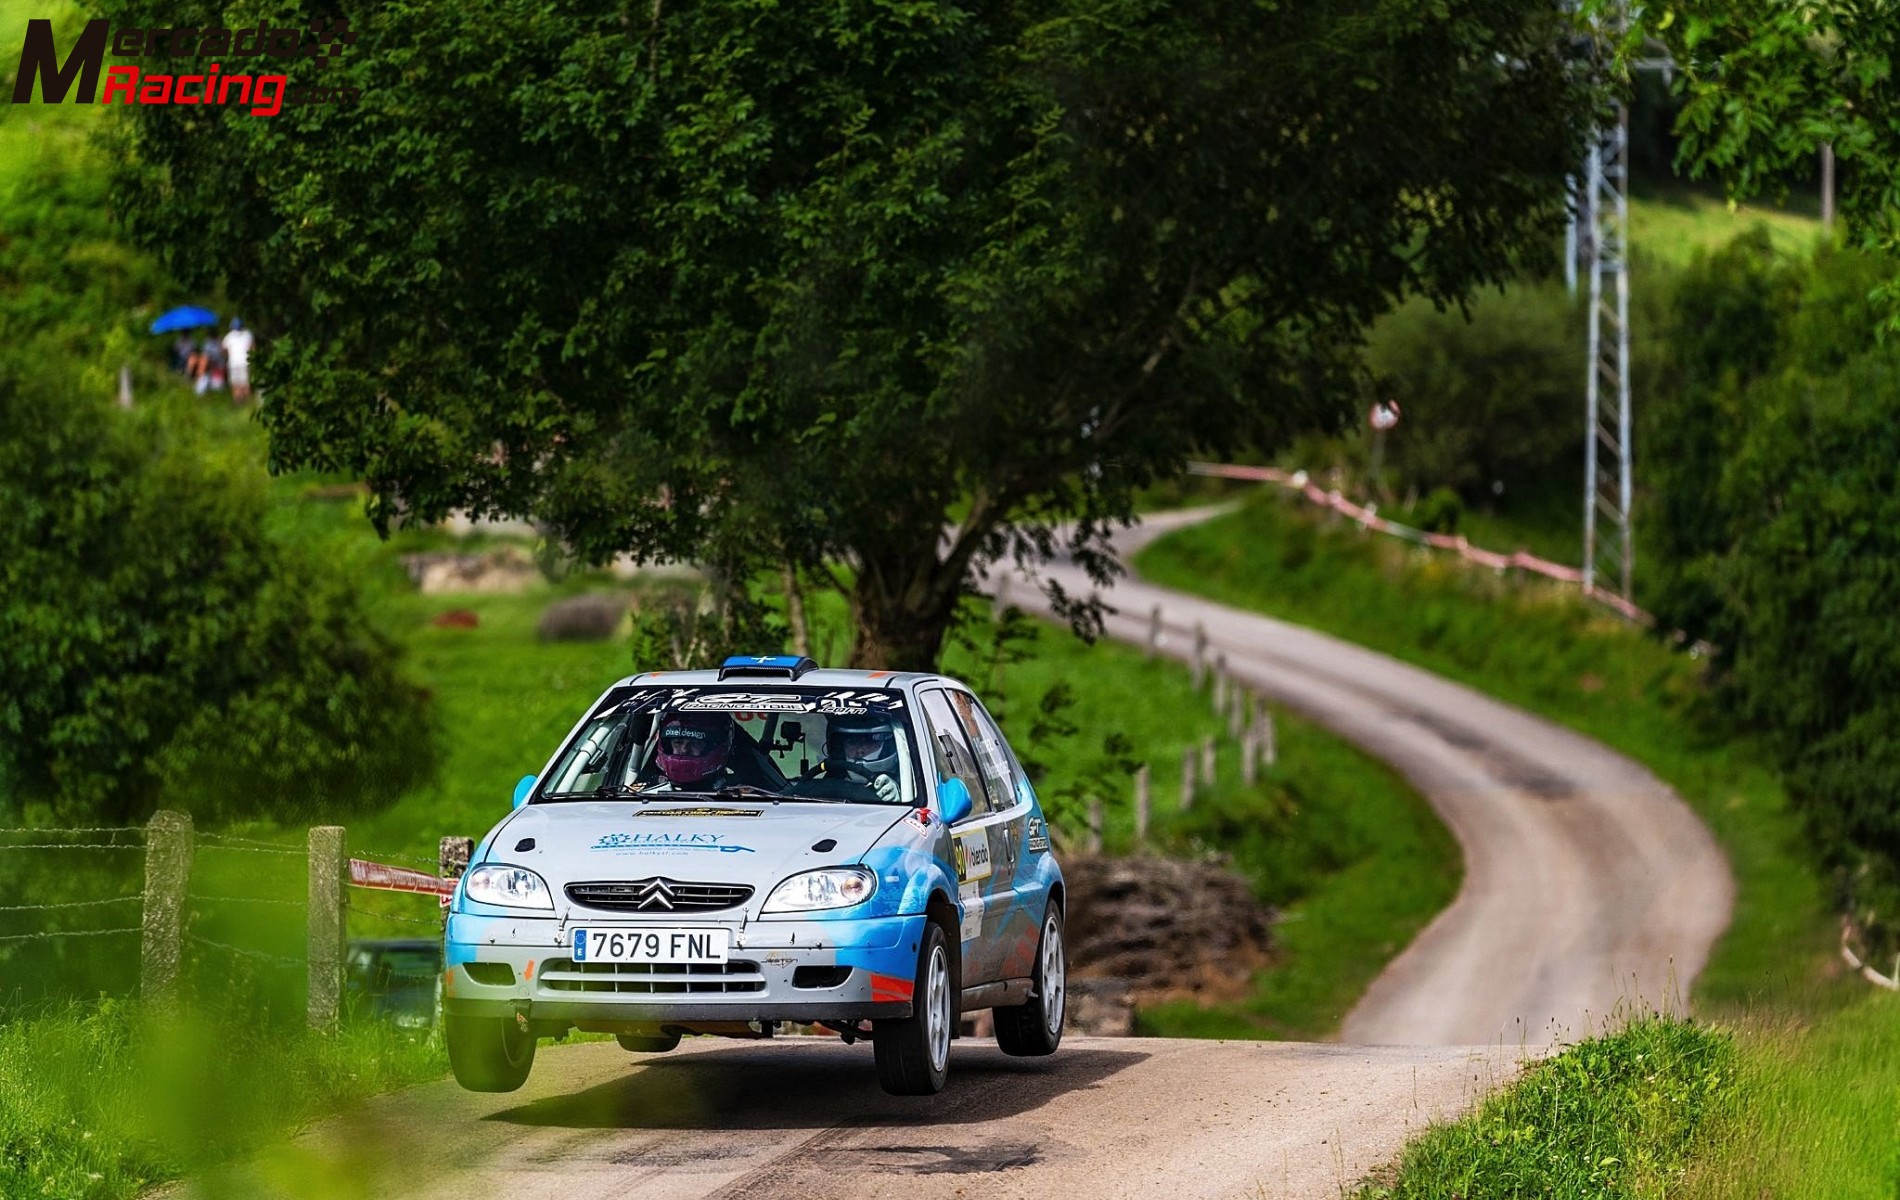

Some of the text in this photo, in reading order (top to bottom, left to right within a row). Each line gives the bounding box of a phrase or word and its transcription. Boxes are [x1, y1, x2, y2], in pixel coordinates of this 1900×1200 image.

[632, 833, 725, 842] HALKY
[592, 933, 721, 959] 7679 FNL
[577, 948, 584, 958] E
